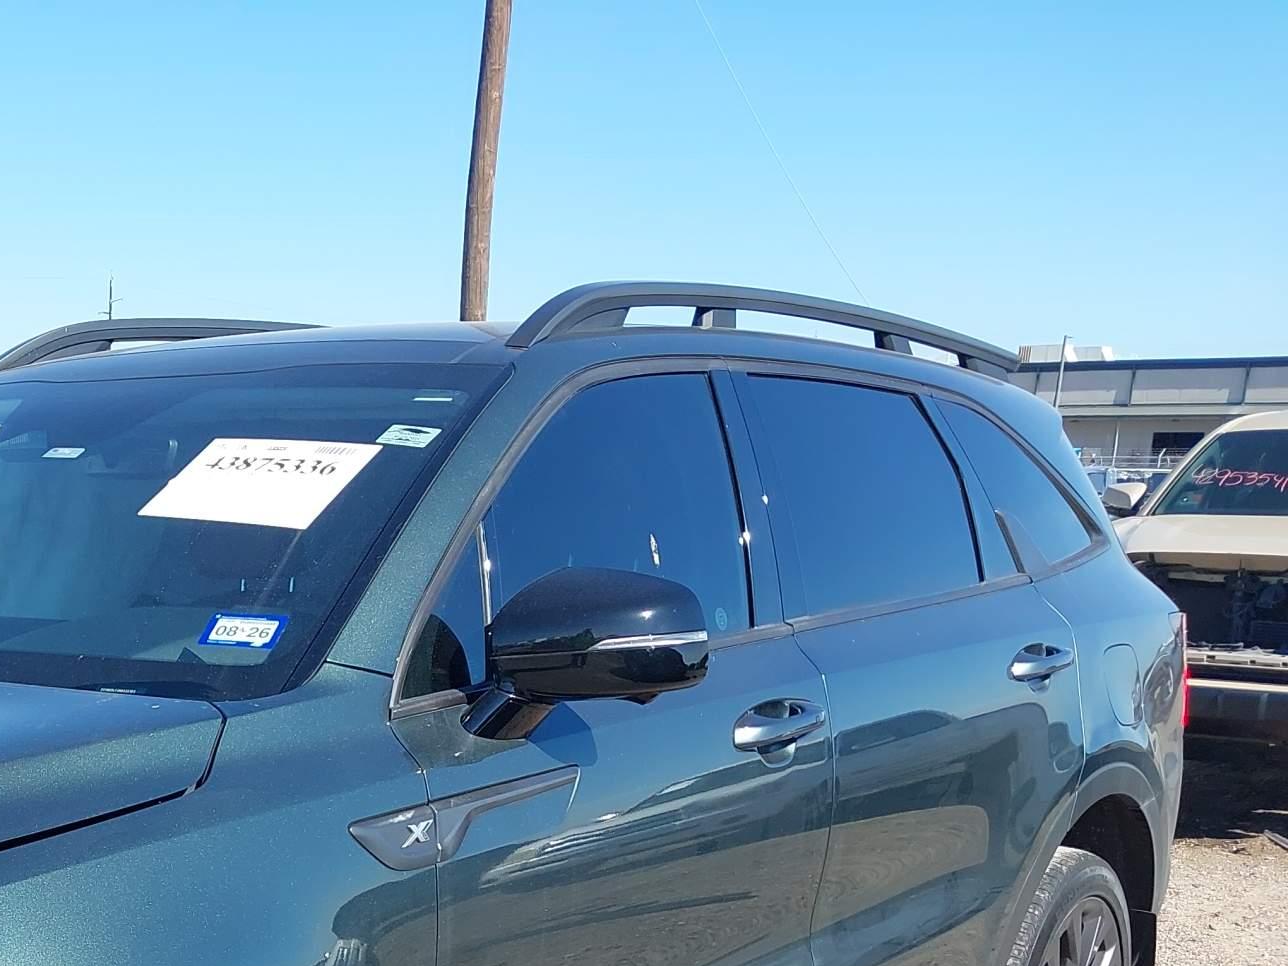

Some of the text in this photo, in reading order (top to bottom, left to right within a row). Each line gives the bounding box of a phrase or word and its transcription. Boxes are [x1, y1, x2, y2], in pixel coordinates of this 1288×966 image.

[206, 456, 338, 475] 43875336
[215, 625, 271, 639] 08 26
